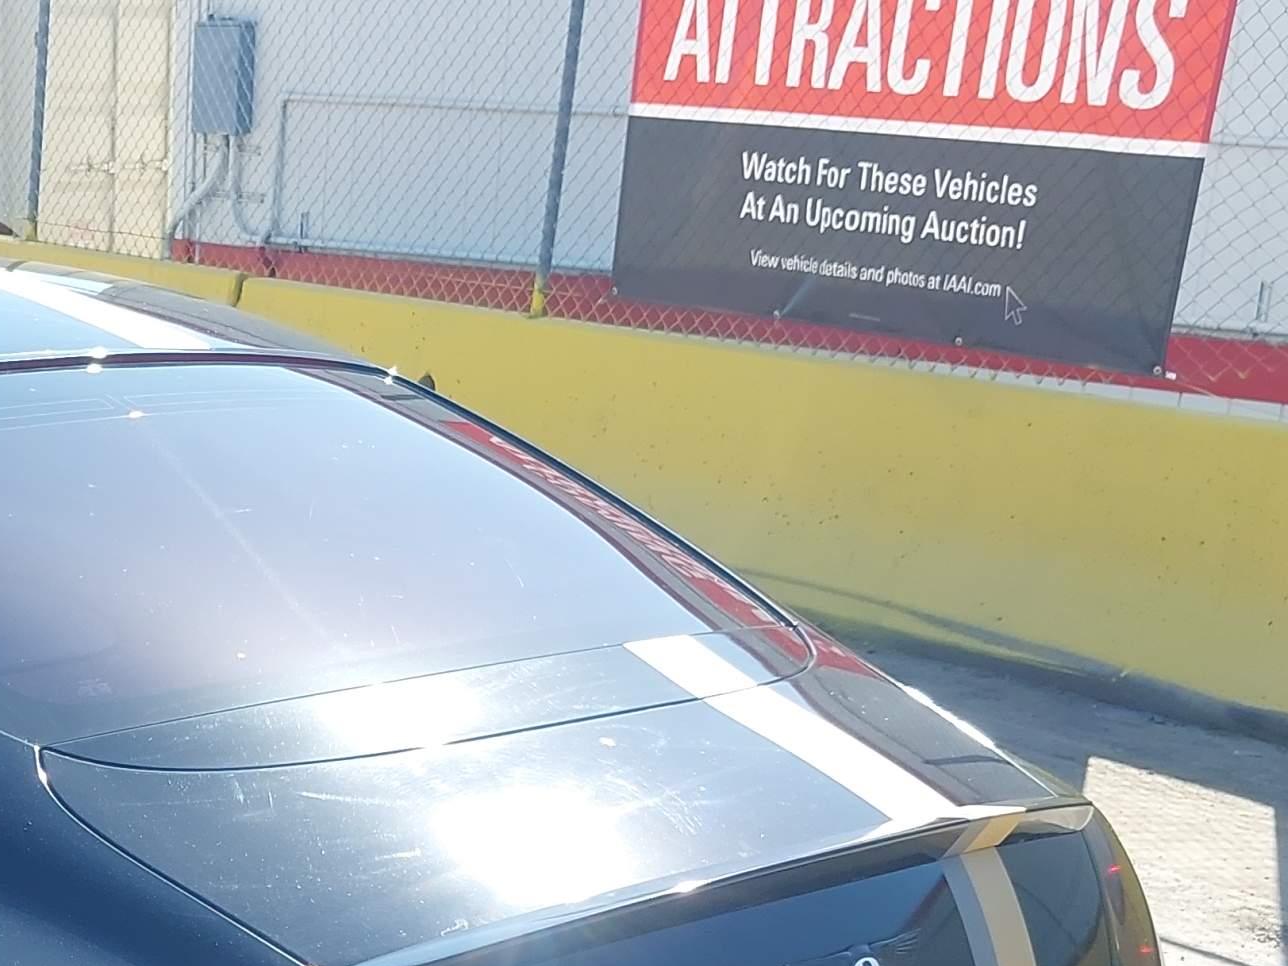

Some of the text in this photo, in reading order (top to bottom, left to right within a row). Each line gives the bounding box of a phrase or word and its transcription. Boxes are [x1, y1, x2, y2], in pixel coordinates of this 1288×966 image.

[663, 0, 1188, 110] ATTRACTIONS
[741, 151, 1038, 207] Watch For These Vehicles
[739, 191, 1027, 249] At An Upcoming Auction!
[750, 249, 1002, 297] View vehicle details and photos at IAAI.com
